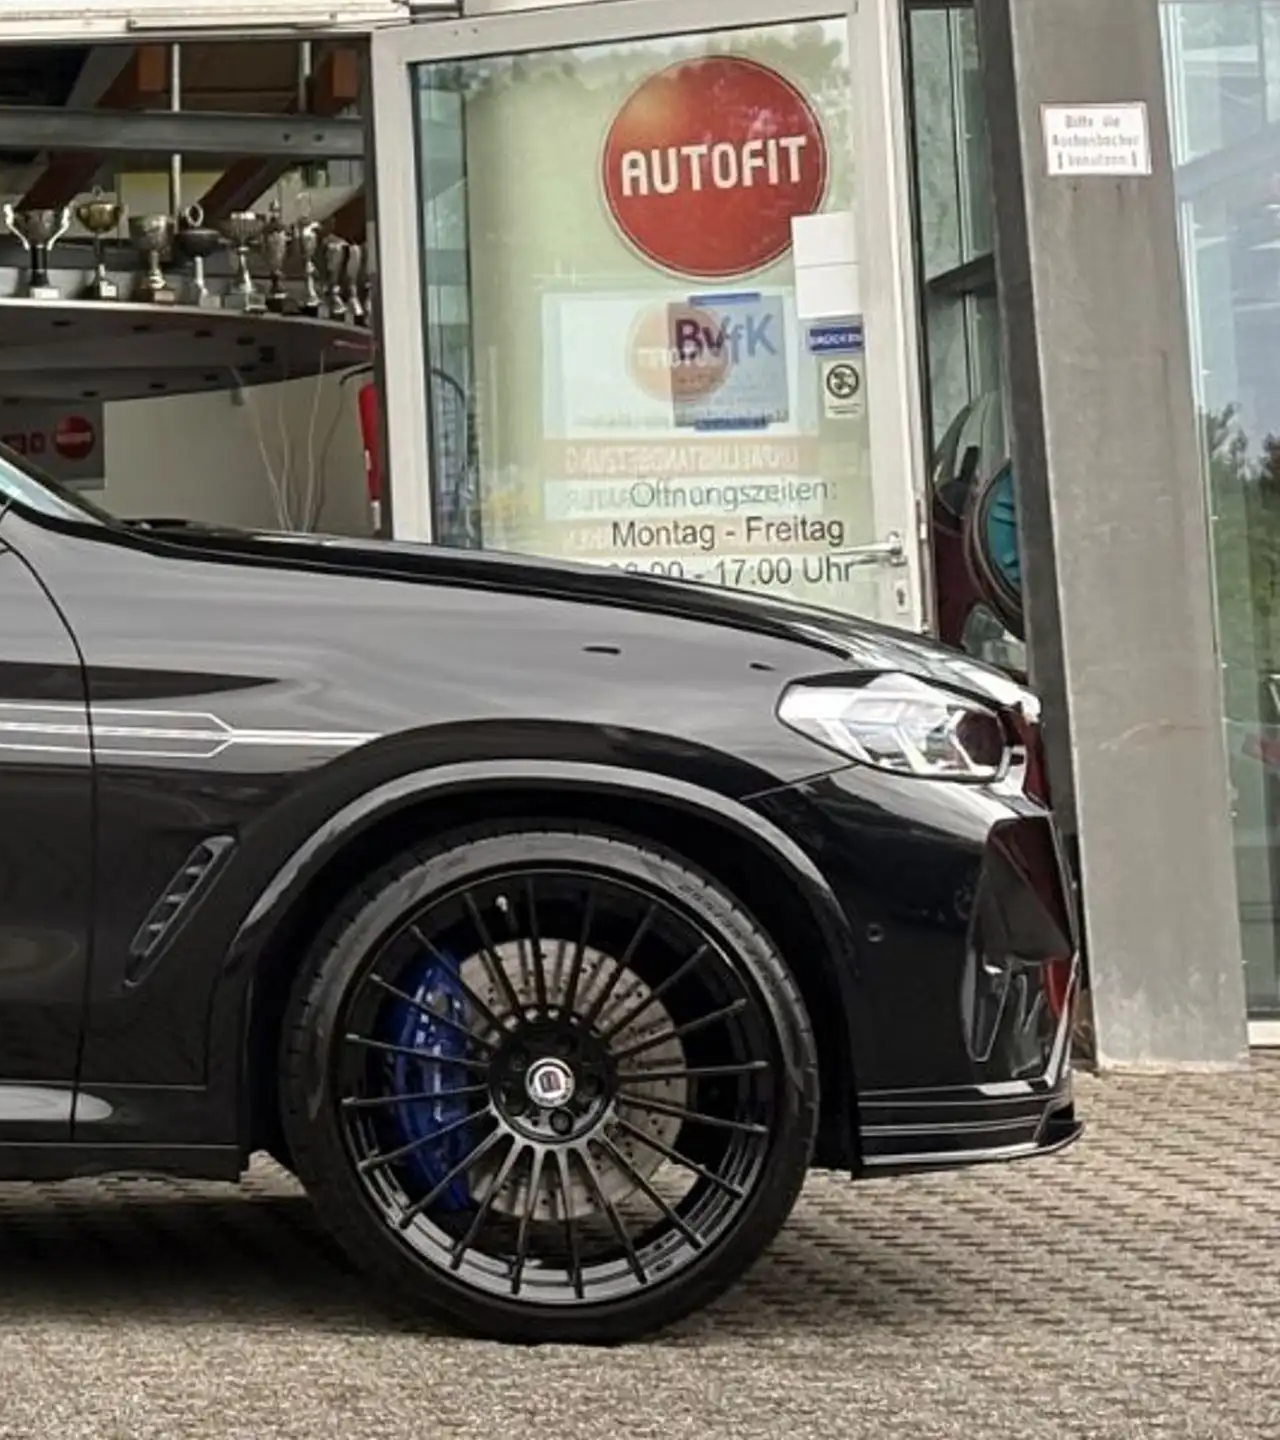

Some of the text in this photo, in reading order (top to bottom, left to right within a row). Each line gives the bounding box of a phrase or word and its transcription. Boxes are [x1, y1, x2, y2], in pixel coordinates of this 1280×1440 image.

[620, 135, 808, 197] AUTOFIT
[629, 476, 838, 512] Öffnungszeiten:
[611, 519, 716, 551] Montag
[745, 515, 845, 547] Freitag
[715, 557, 792, 586] 17:00
[802, 555, 857, 584] Uhr
